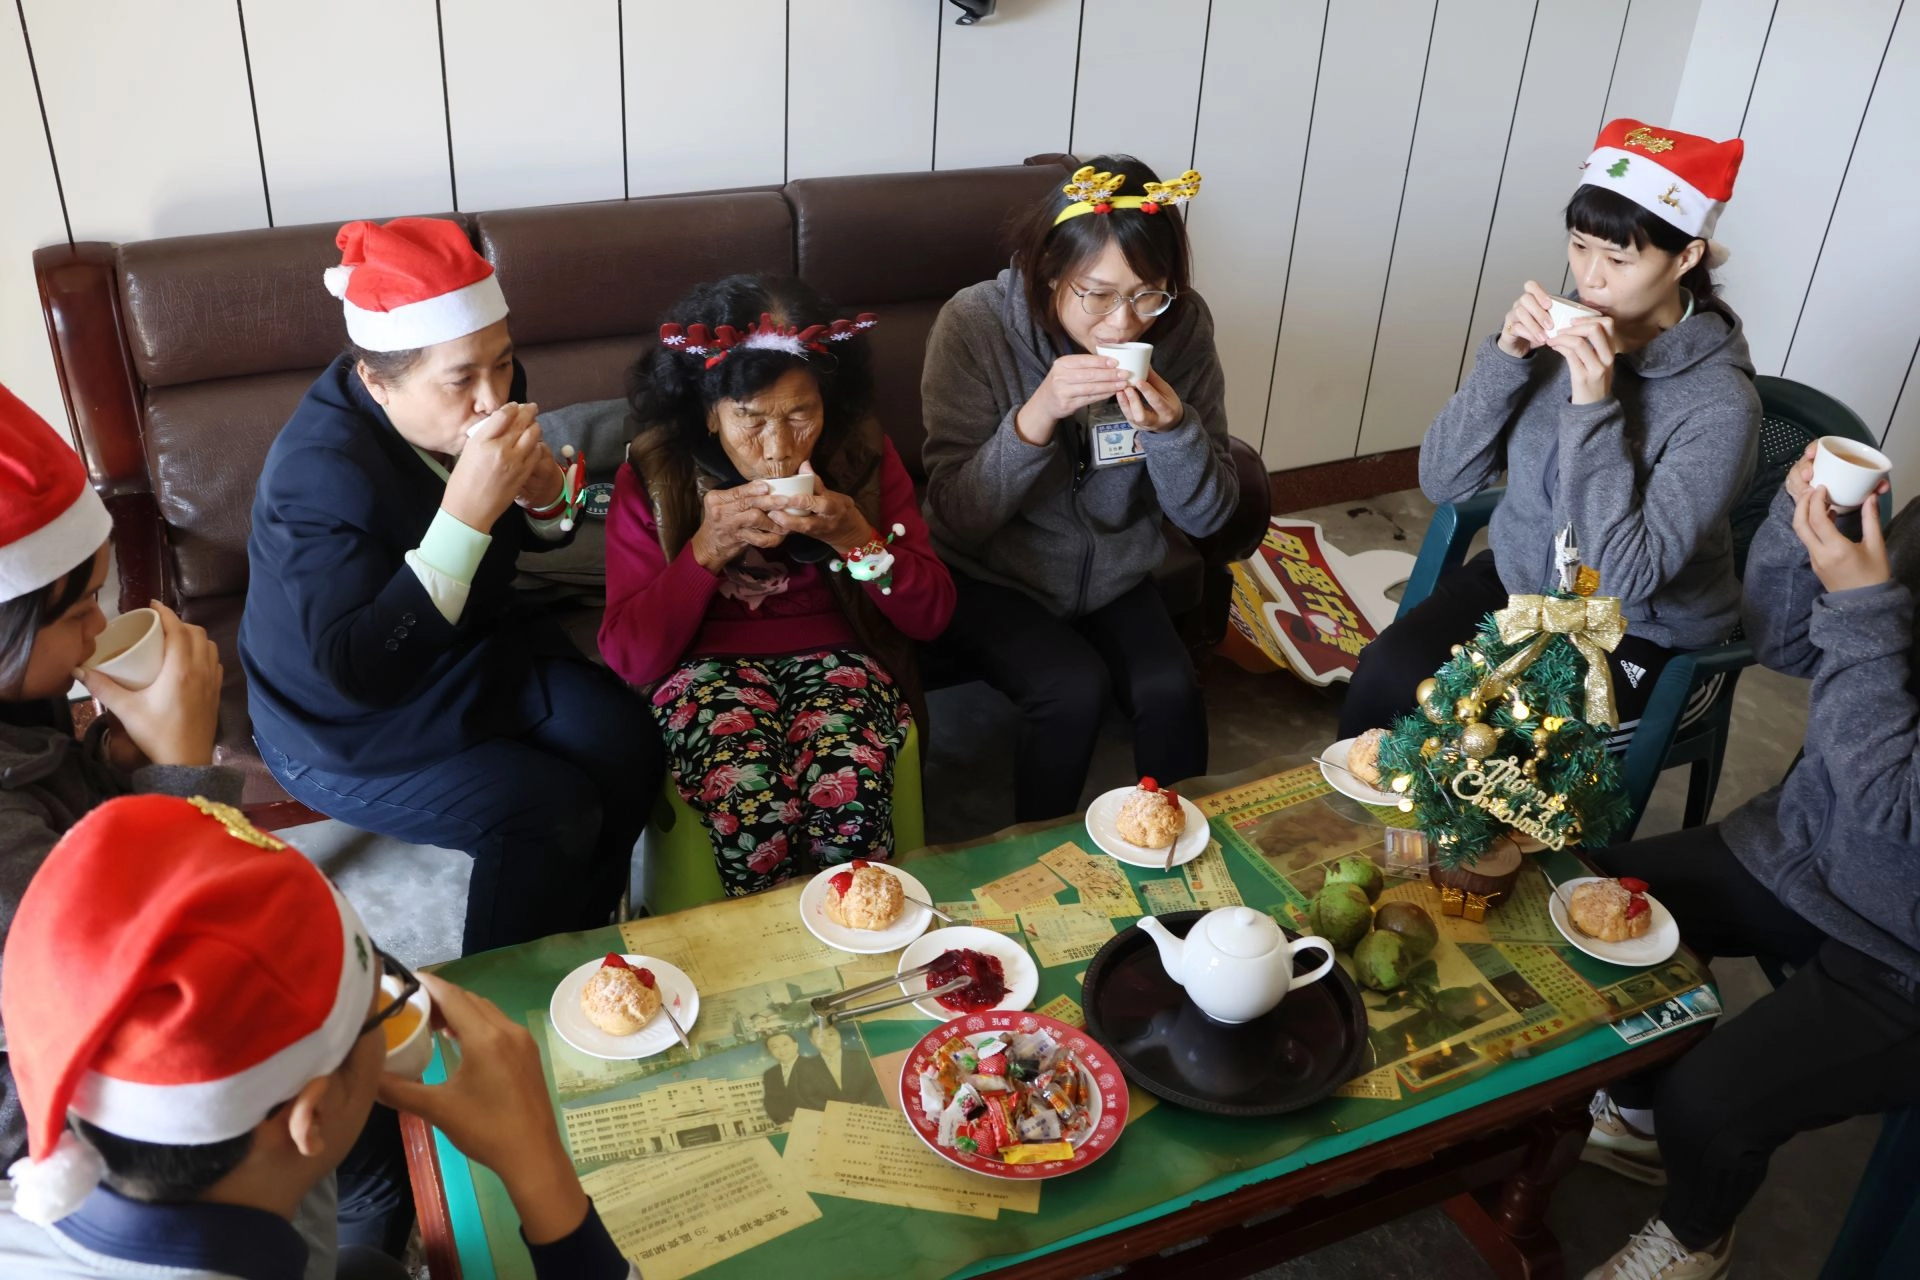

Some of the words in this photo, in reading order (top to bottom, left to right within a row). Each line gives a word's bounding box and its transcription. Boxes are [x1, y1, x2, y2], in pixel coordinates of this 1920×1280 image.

[1620, 660, 1638, 688] adidas
[1452, 770, 1566, 852] Christmas
[992, 1017, 1011, 1026] 孔雀
[943, 1026, 960, 1039] 孔雀
[1044, 1026, 1063, 1039] 孔雀
[1086, 1055, 1102, 1070] 孔雀
[1107, 1093, 1116, 1109] 孔雀
